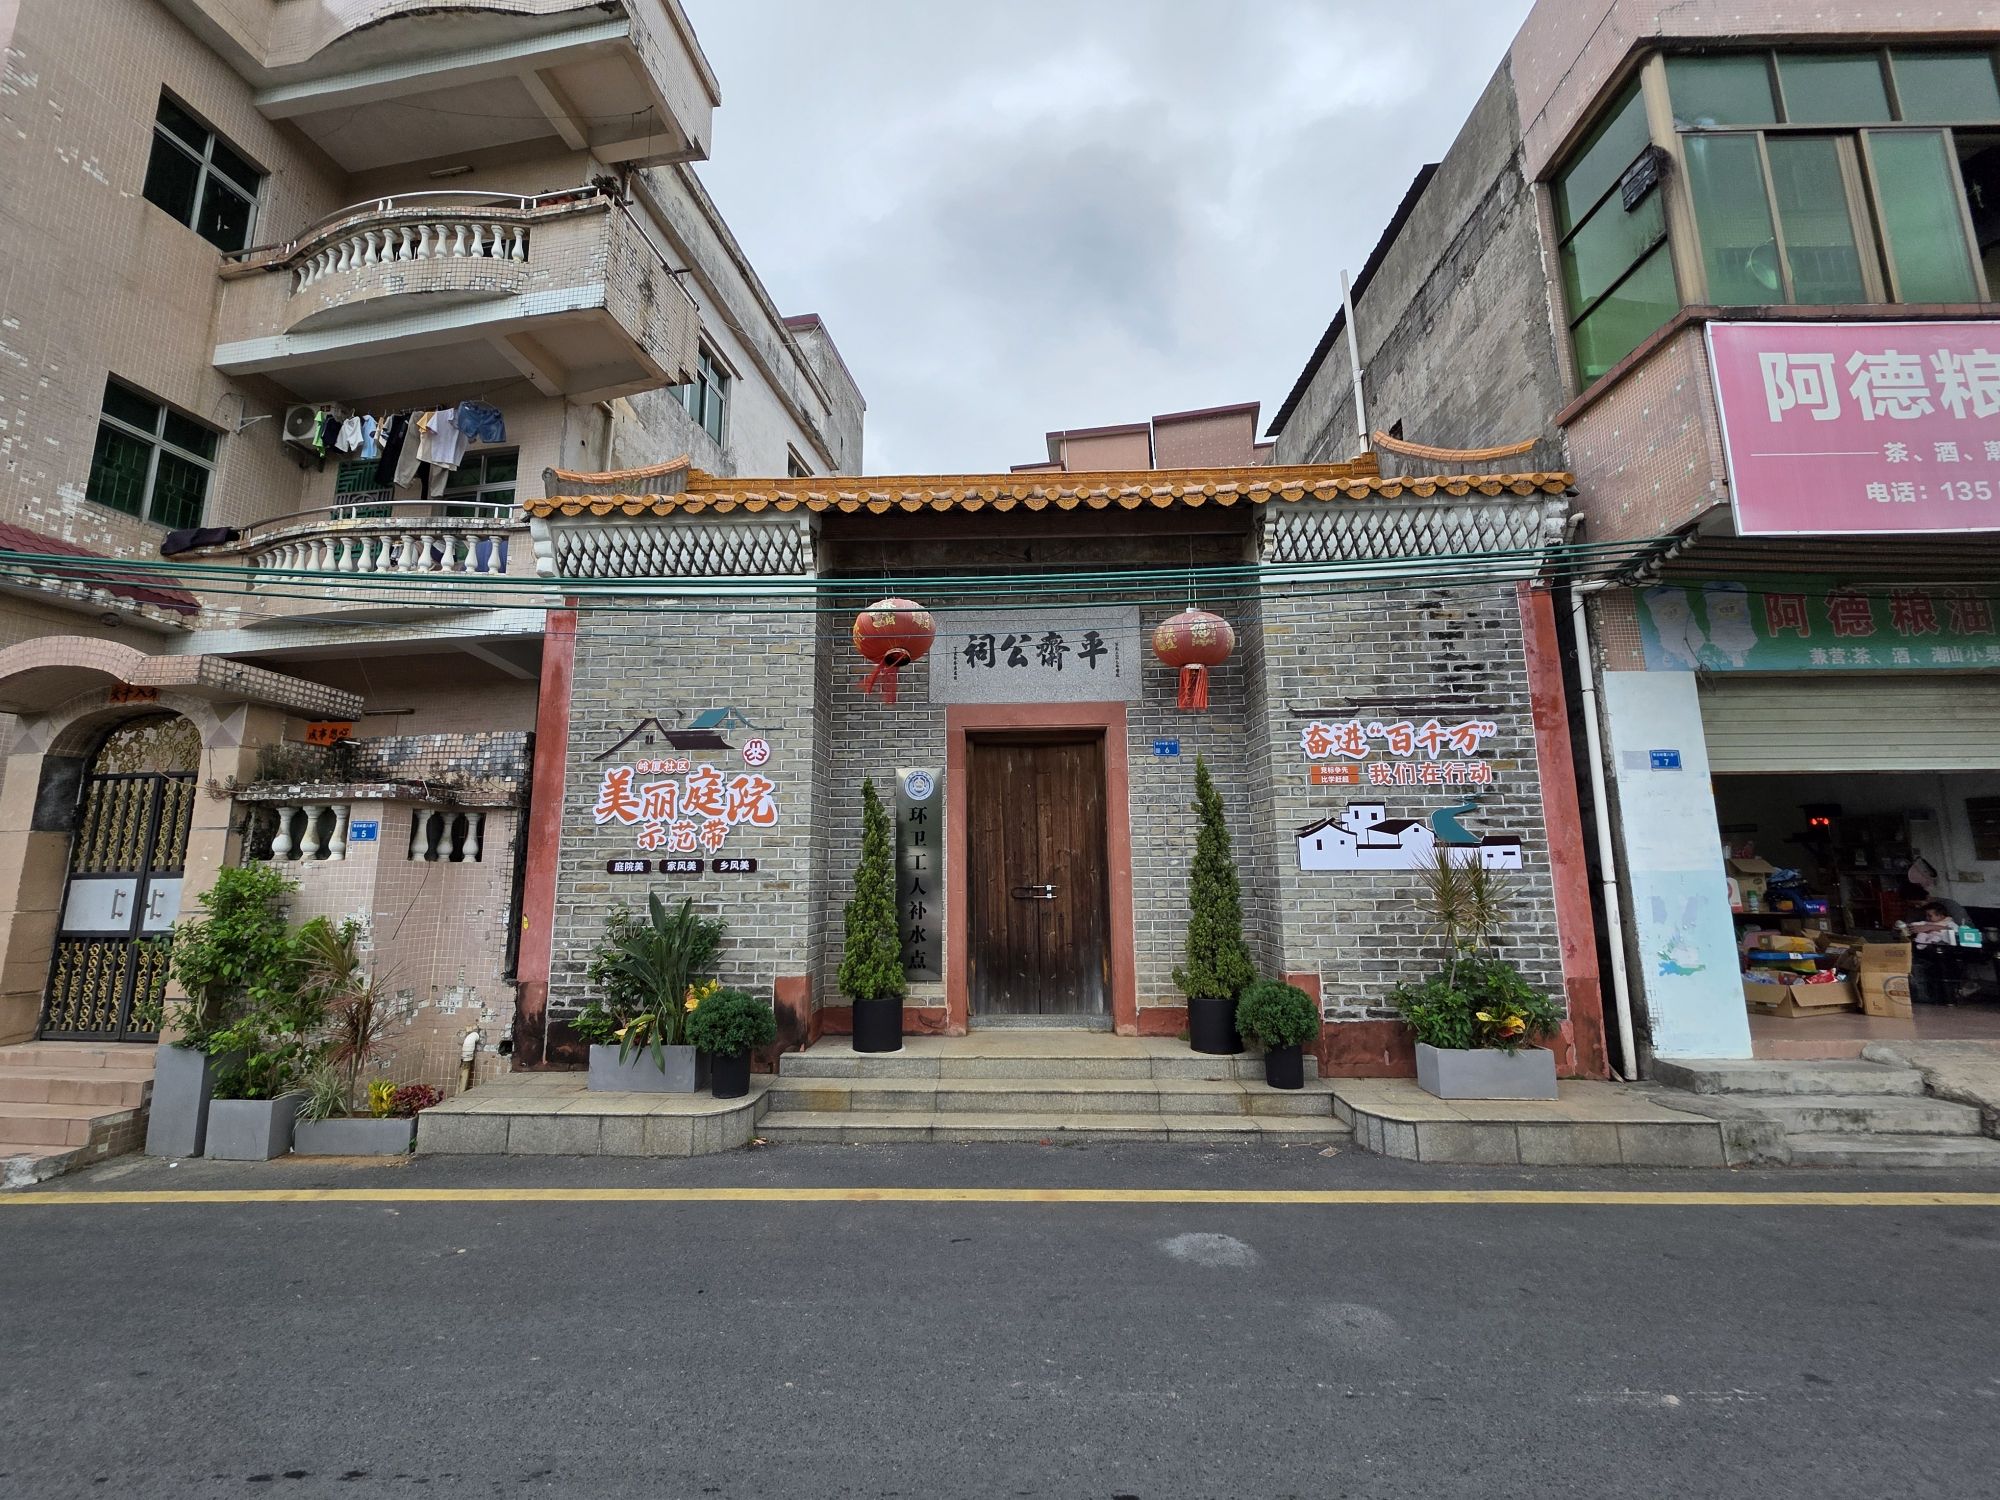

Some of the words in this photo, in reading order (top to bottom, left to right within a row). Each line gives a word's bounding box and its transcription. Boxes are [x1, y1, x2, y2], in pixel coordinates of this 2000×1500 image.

[1758, 349, 2000, 422] 阿德粮
[1763, 589, 1996, 638] 阿德粮油
[1368, 761, 1493, 786] 我们在行动
[595, 767, 775, 825] 美丽庭院
[639, 818, 729, 852] 示范带
[614, 861, 644, 872] 庭院美
[667, 861, 697, 871] 家风美
[720, 860, 750, 871] 乡风美
[908, 806, 927, 970] 环卫工人补水点
